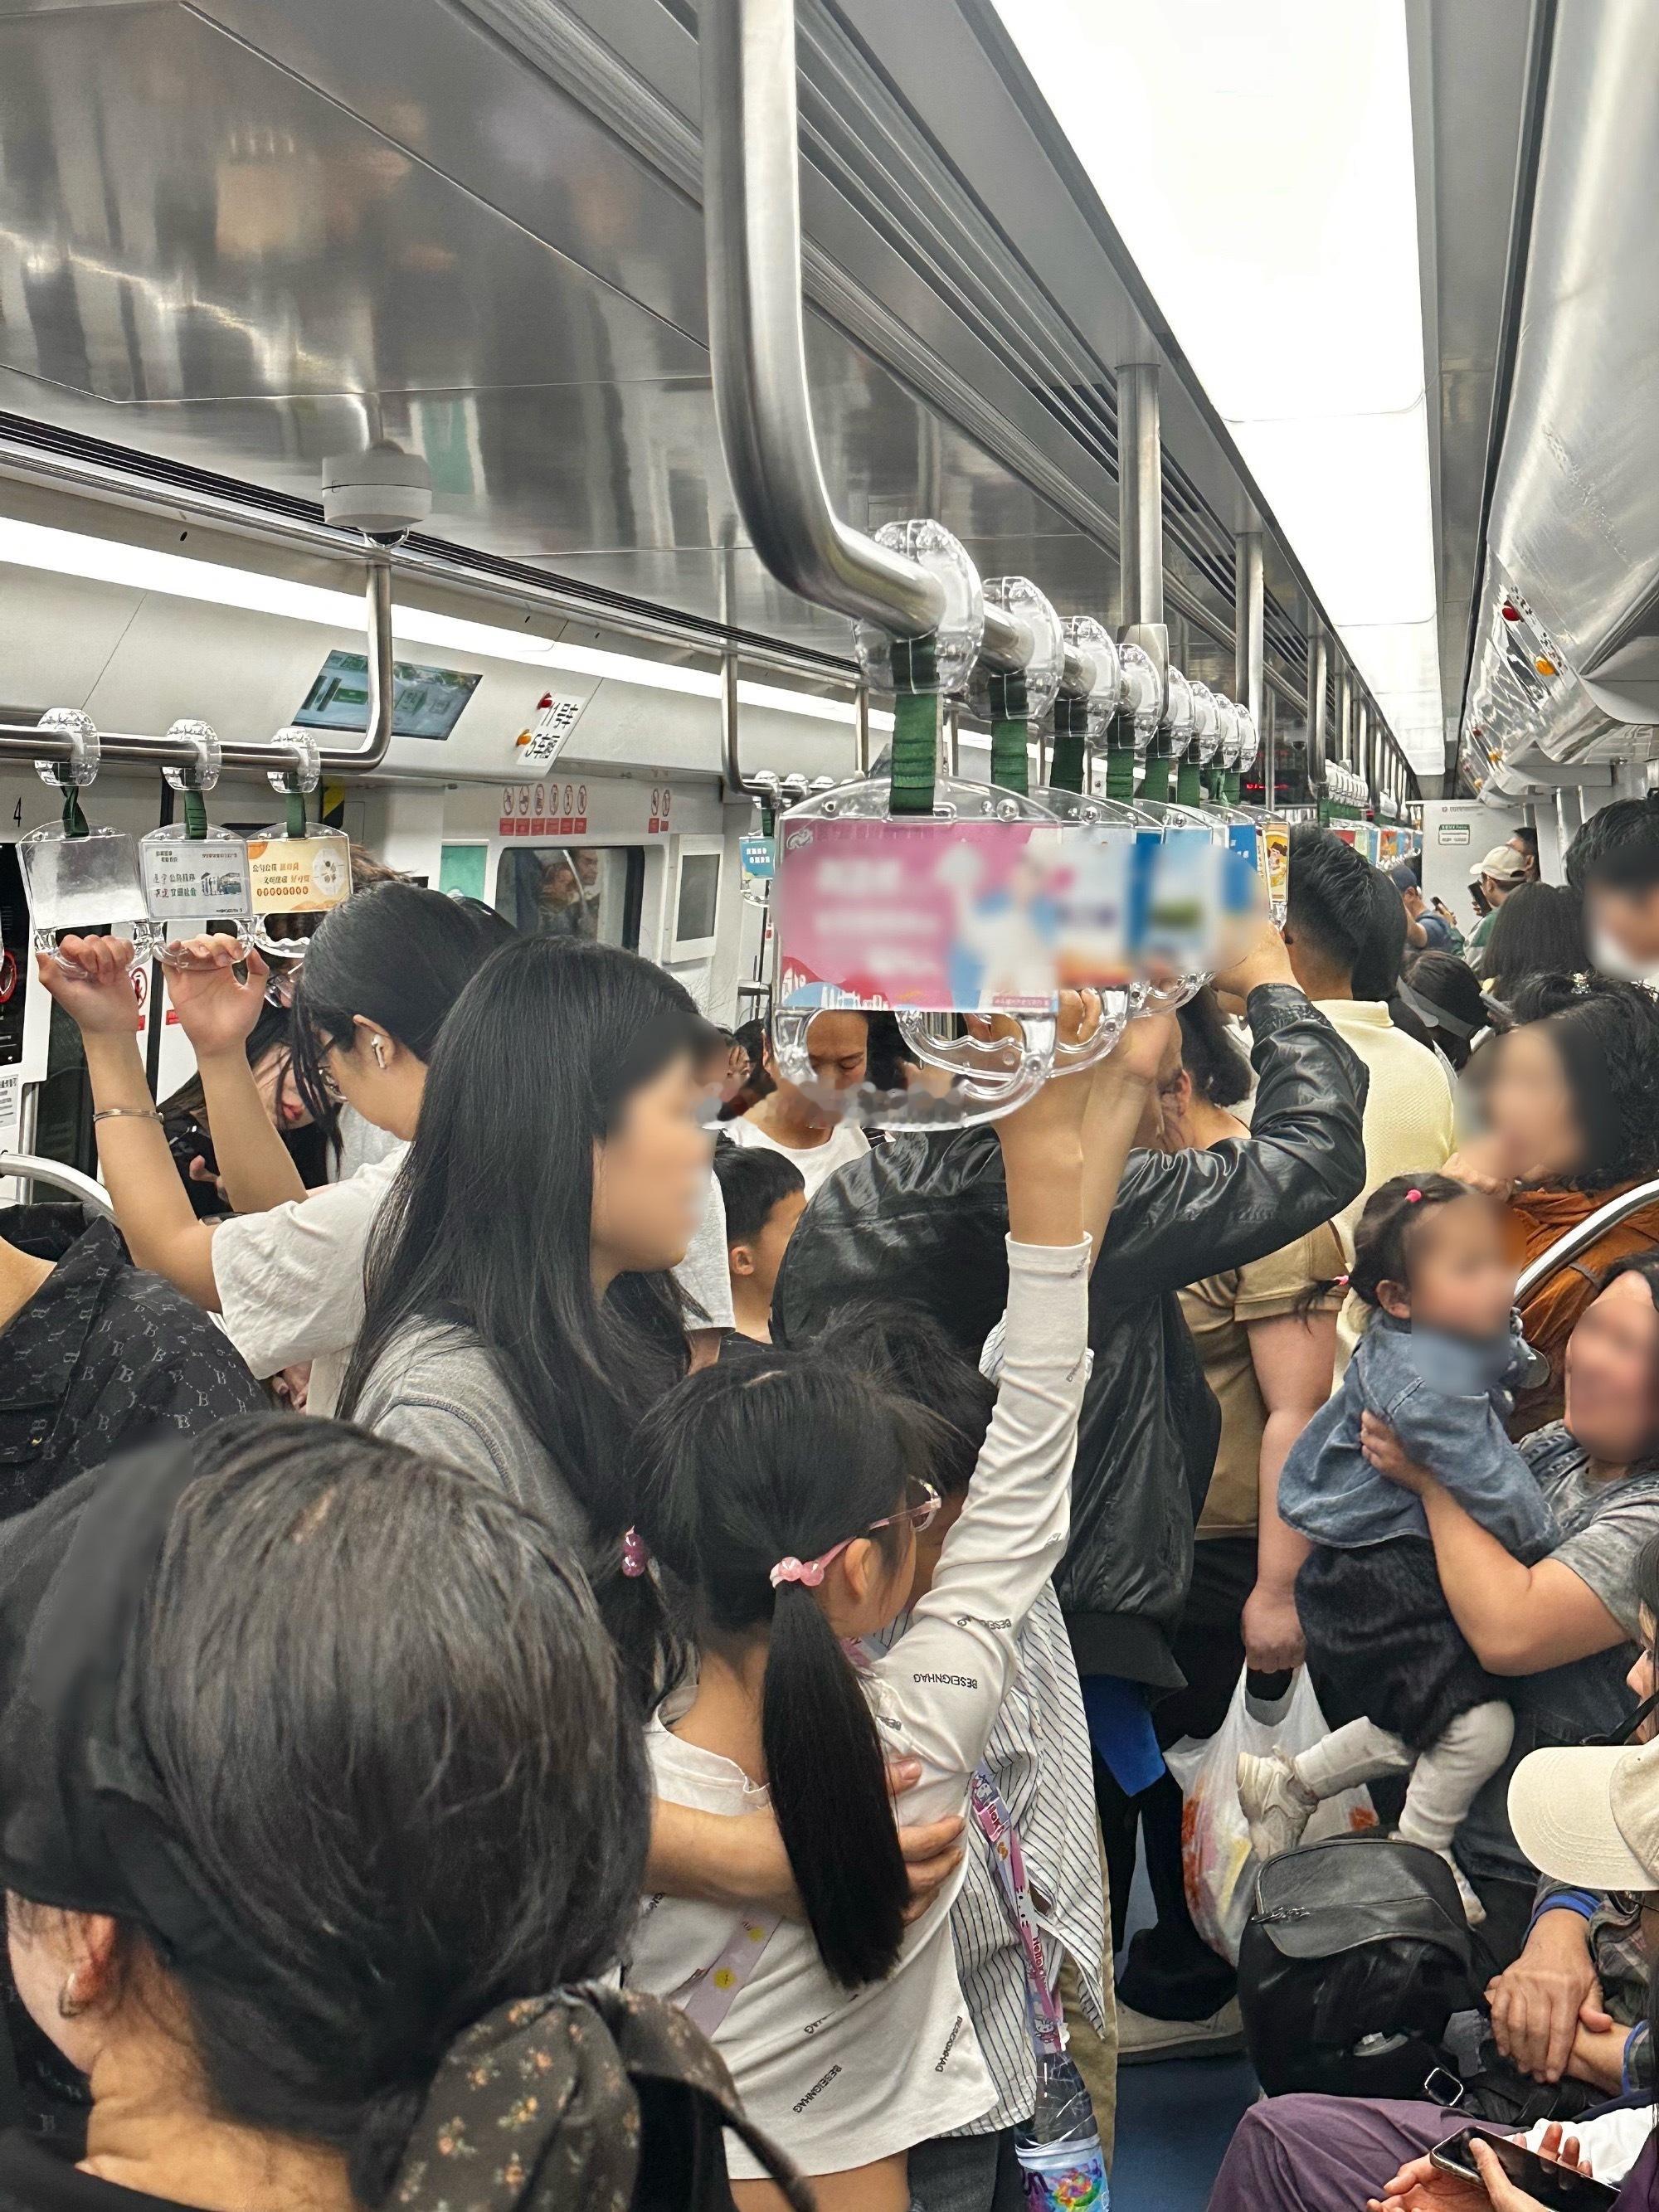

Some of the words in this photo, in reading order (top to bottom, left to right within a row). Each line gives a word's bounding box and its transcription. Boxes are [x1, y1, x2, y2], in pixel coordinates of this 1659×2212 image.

[13, 797, 22, 828] 4
[80, 1367, 94, 1380] B
[118, 1365, 134, 1382] B
[197, 1390, 209, 1406] B
[174, 1414, 190, 1428] B
